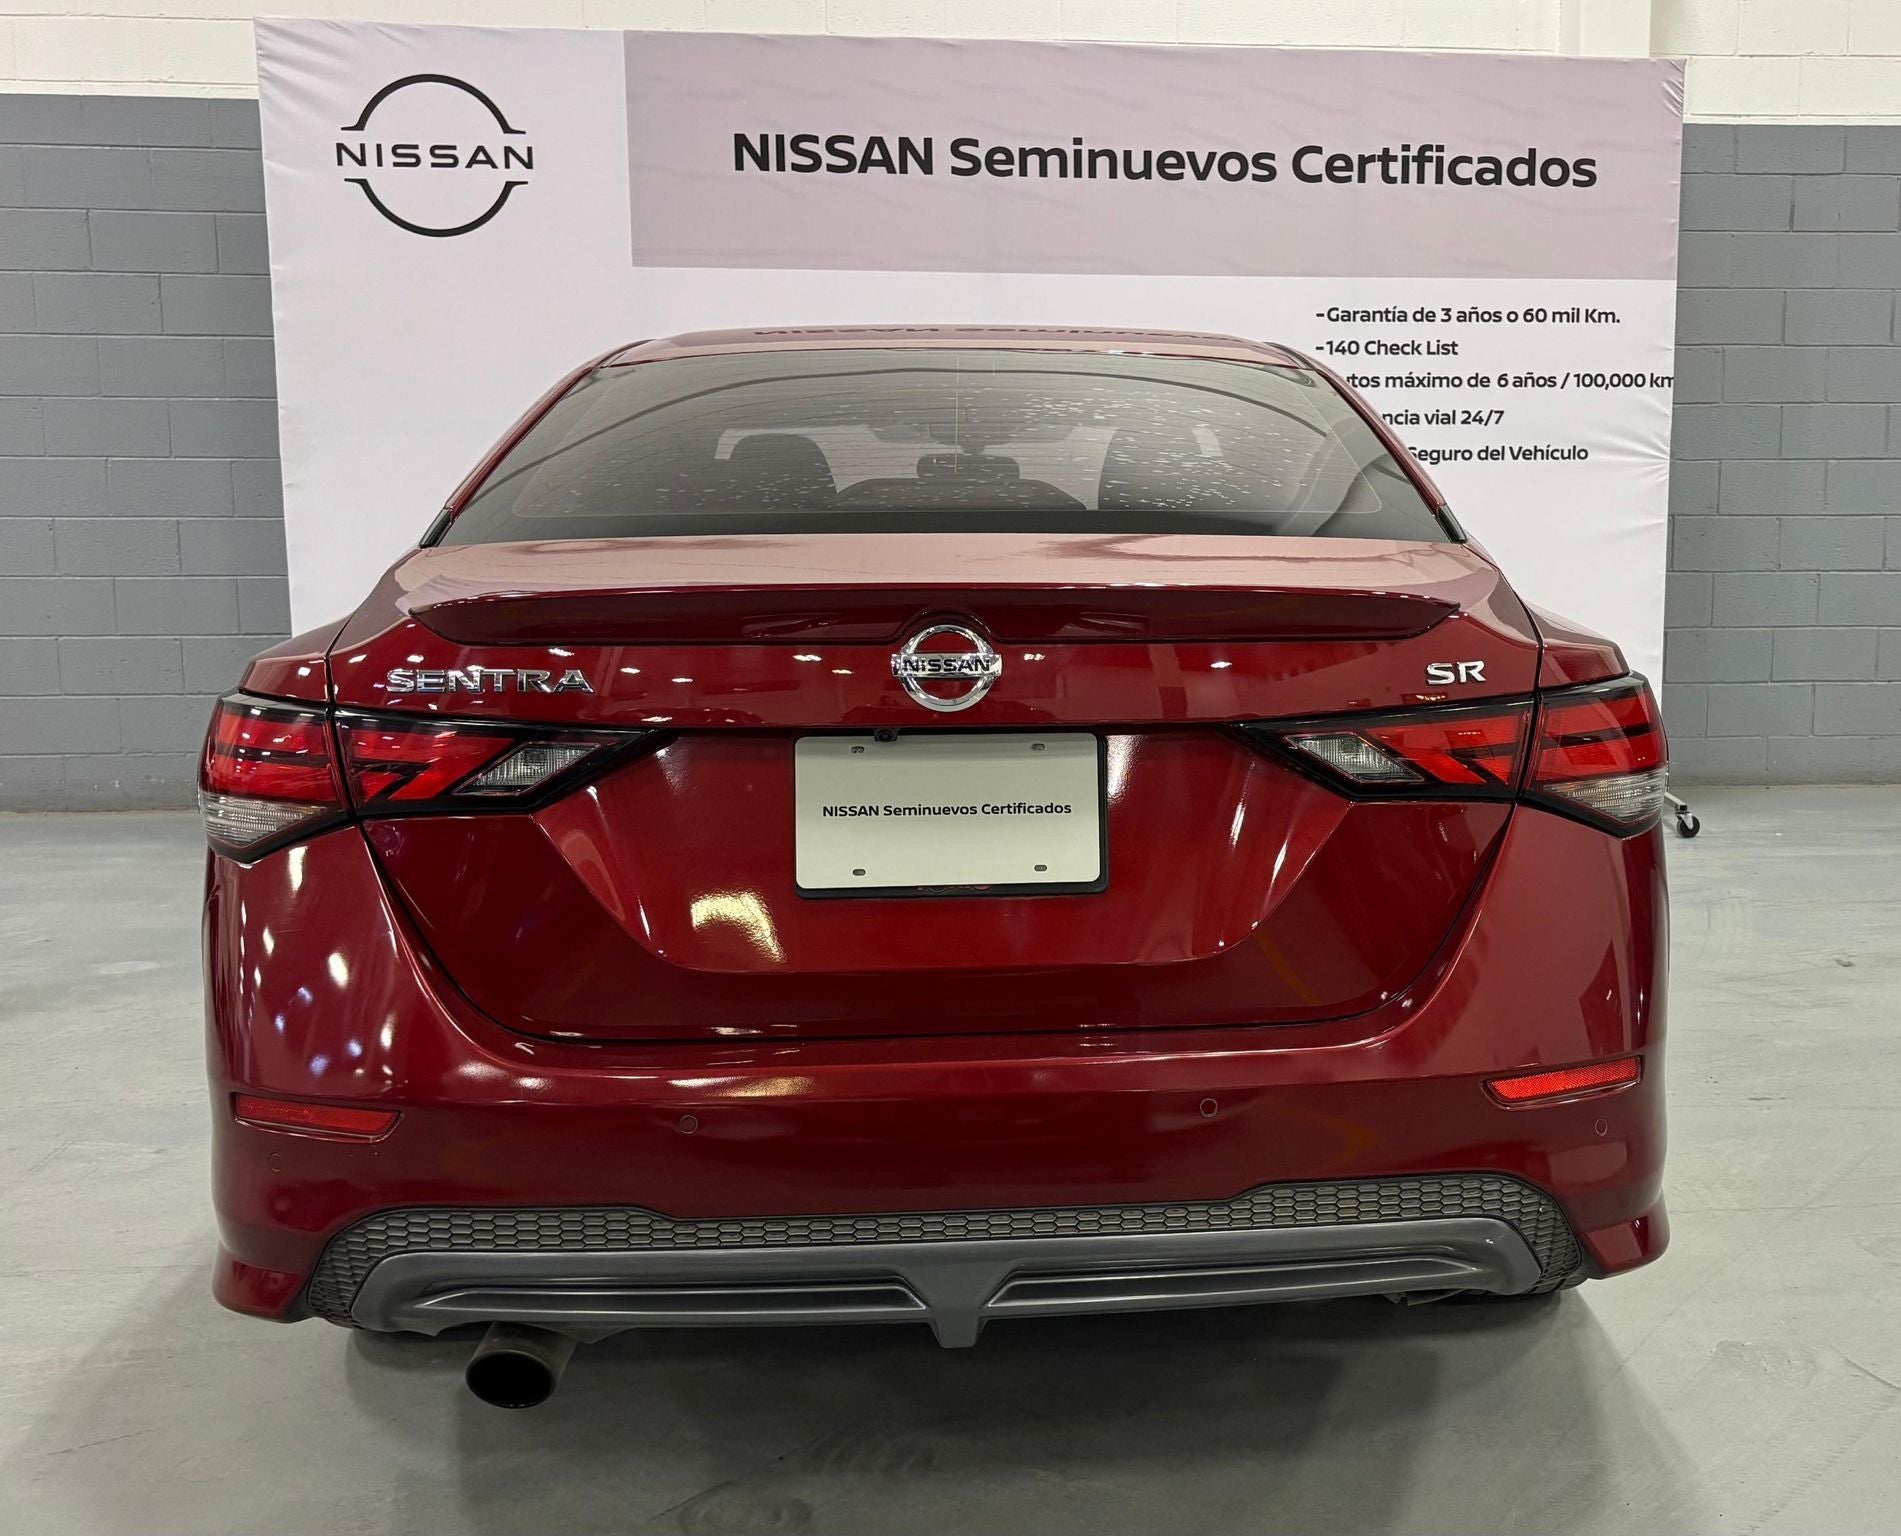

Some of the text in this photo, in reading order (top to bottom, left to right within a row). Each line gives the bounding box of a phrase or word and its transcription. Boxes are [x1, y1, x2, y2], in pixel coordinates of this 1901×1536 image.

[335, 142, 534, 170] NISSAN
[733, 133, 1597, 188] NISSAN Seminuevos Certificados
[1315, 305, 1621, 324] -Garantía de 3 años o 60 mil Km.
[1315, 339, 1459, 356] -140 Check List
[1346, 373, 1381, 388] tos
[1384, 371, 1463, 389] máximo
[1466, 372, 1491, 389] de
[1497, 372, 1509, 388] 6
[1512, 371, 1558, 388] años
[1573, 372, 1647, 391] 100,000
[1382, 408, 1505, 427] ncia vial 24/7
[1476, 445, 1506, 461] del
[1508, 444, 1589, 462] Vehículo
[903, 658, 991, 673] NISSAN
[1425, 660, 1487, 685] SR
[386, 667, 595, 693] SENTRA
[822, 802, 1072, 817] NISSAN Seminuevos Certificados
